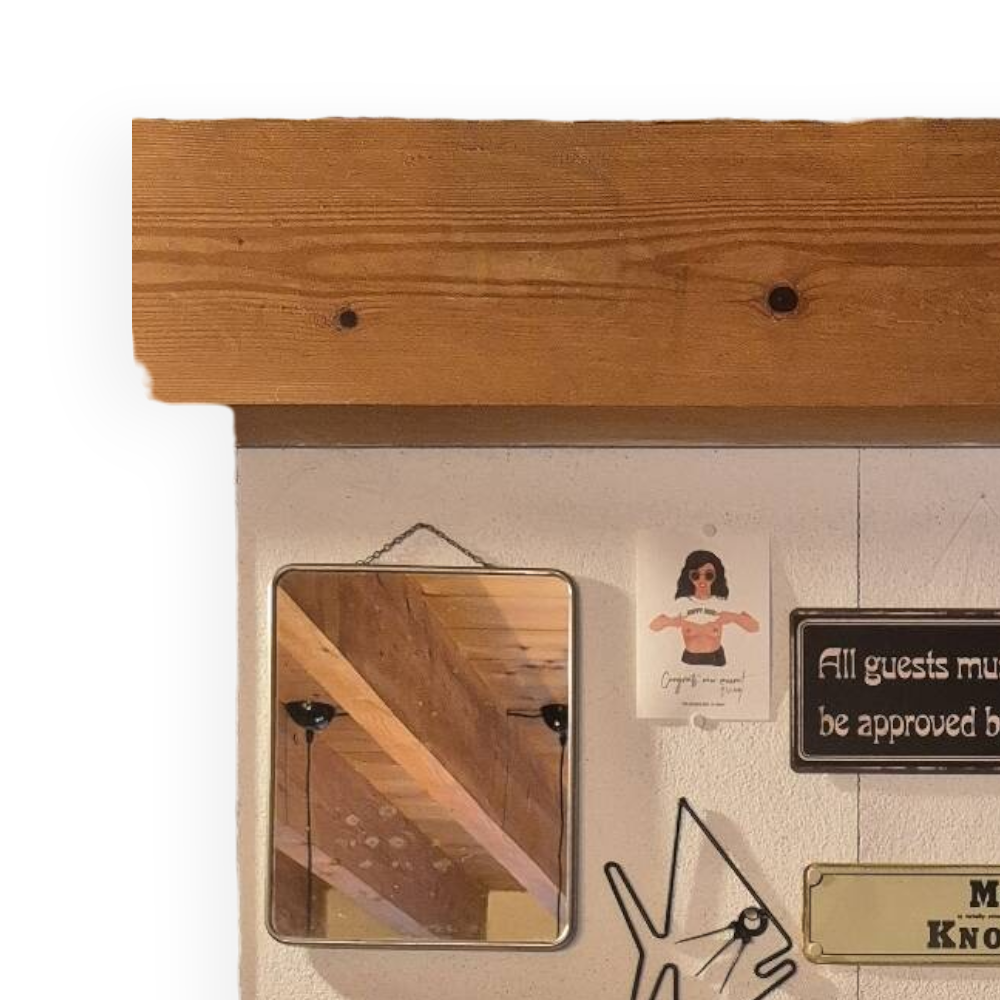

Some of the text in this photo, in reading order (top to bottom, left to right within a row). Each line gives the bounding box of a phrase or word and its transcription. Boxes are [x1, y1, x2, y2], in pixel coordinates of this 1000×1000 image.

[820, 647, 856, 679] All
[864, 650, 949, 686] guests
[819, 706, 849, 737] be
[857, 706, 976, 744] approved
